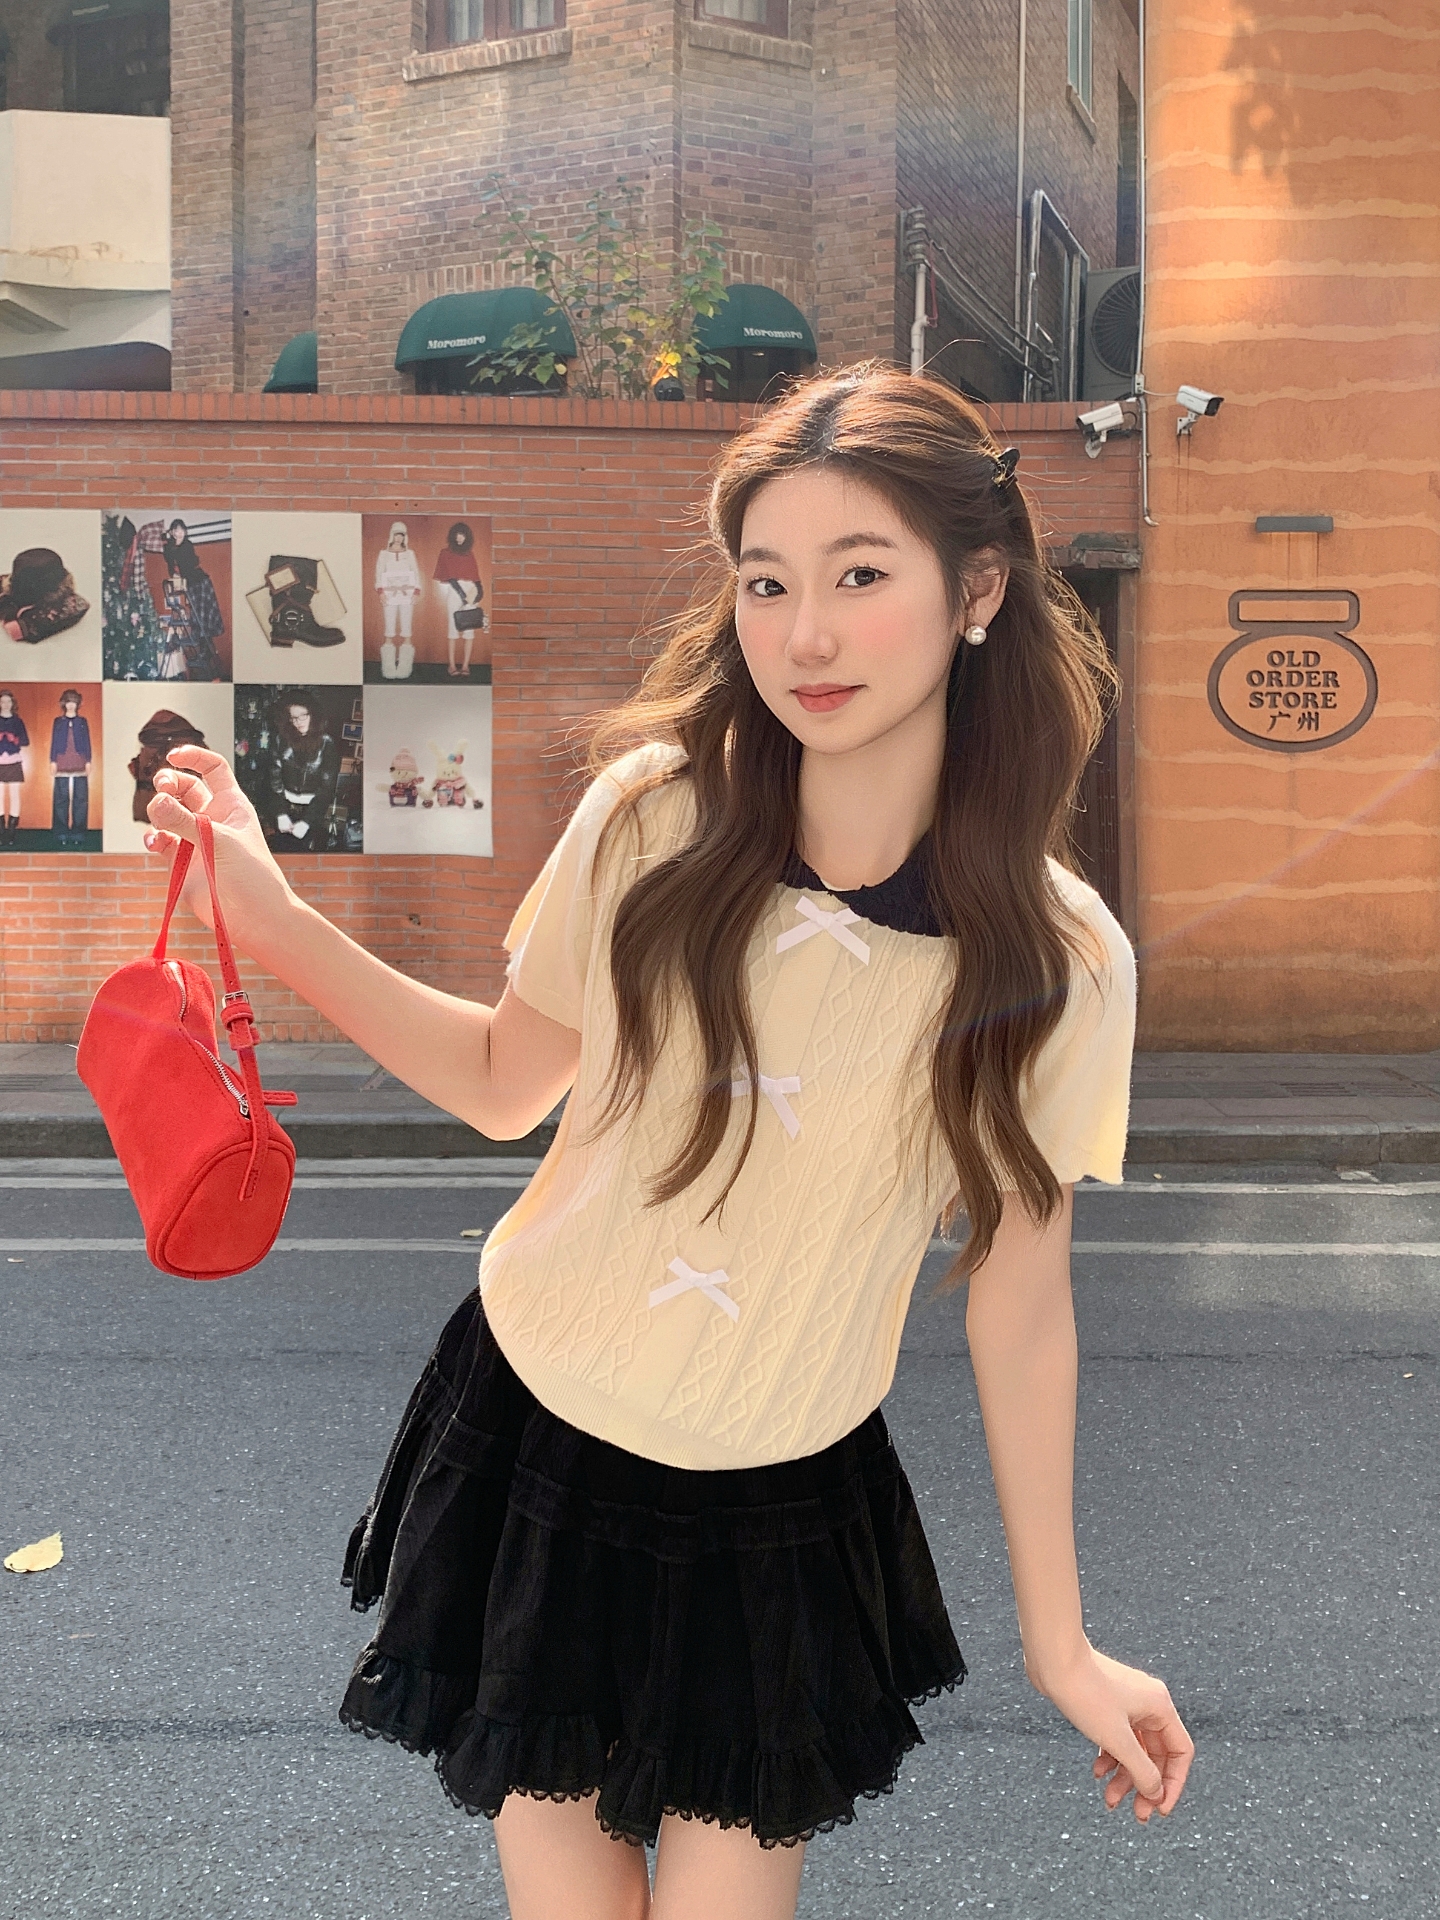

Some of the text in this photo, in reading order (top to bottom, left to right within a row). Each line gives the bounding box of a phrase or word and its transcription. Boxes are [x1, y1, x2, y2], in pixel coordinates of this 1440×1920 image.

[743, 327, 803, 339] Moromoro
[427, 335, 486, 349] Moromoro
[1267, 650, 1321, 667] OLD
[1246, 670, 1340, 687] ORDER
[1249, 692, 1337, 709] STORE
[1267, 711, 1320, 732] 广州
